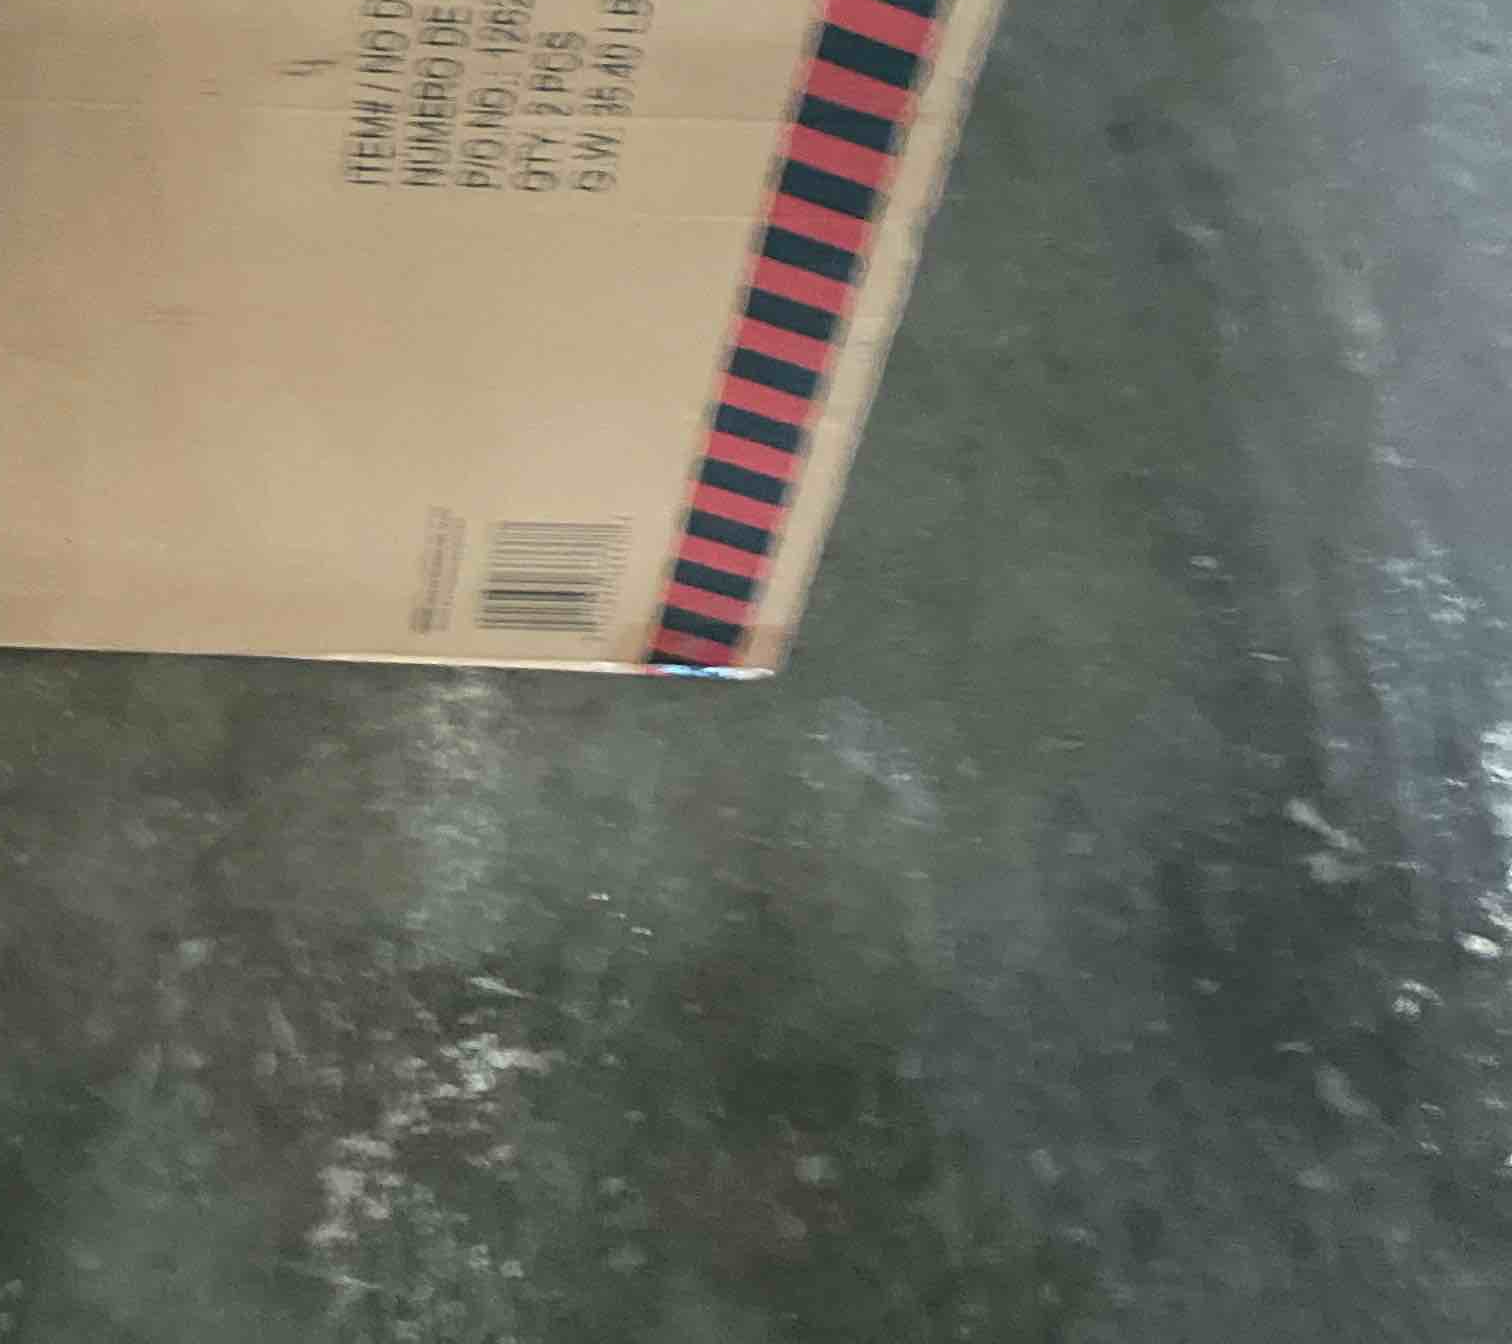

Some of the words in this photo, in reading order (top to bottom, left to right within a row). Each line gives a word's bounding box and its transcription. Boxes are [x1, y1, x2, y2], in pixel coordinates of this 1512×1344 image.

[358, 29, 412, 74] NO
[417, 4, 473, 48] DE
[526, 30, 588, 93] PCS
[400, 56, 467, 189] NÚMERO
[525, 102, 567, 117] 2
[343, 101, 398, 186] ITEM#
[455, 139, 506, 190] P/O
